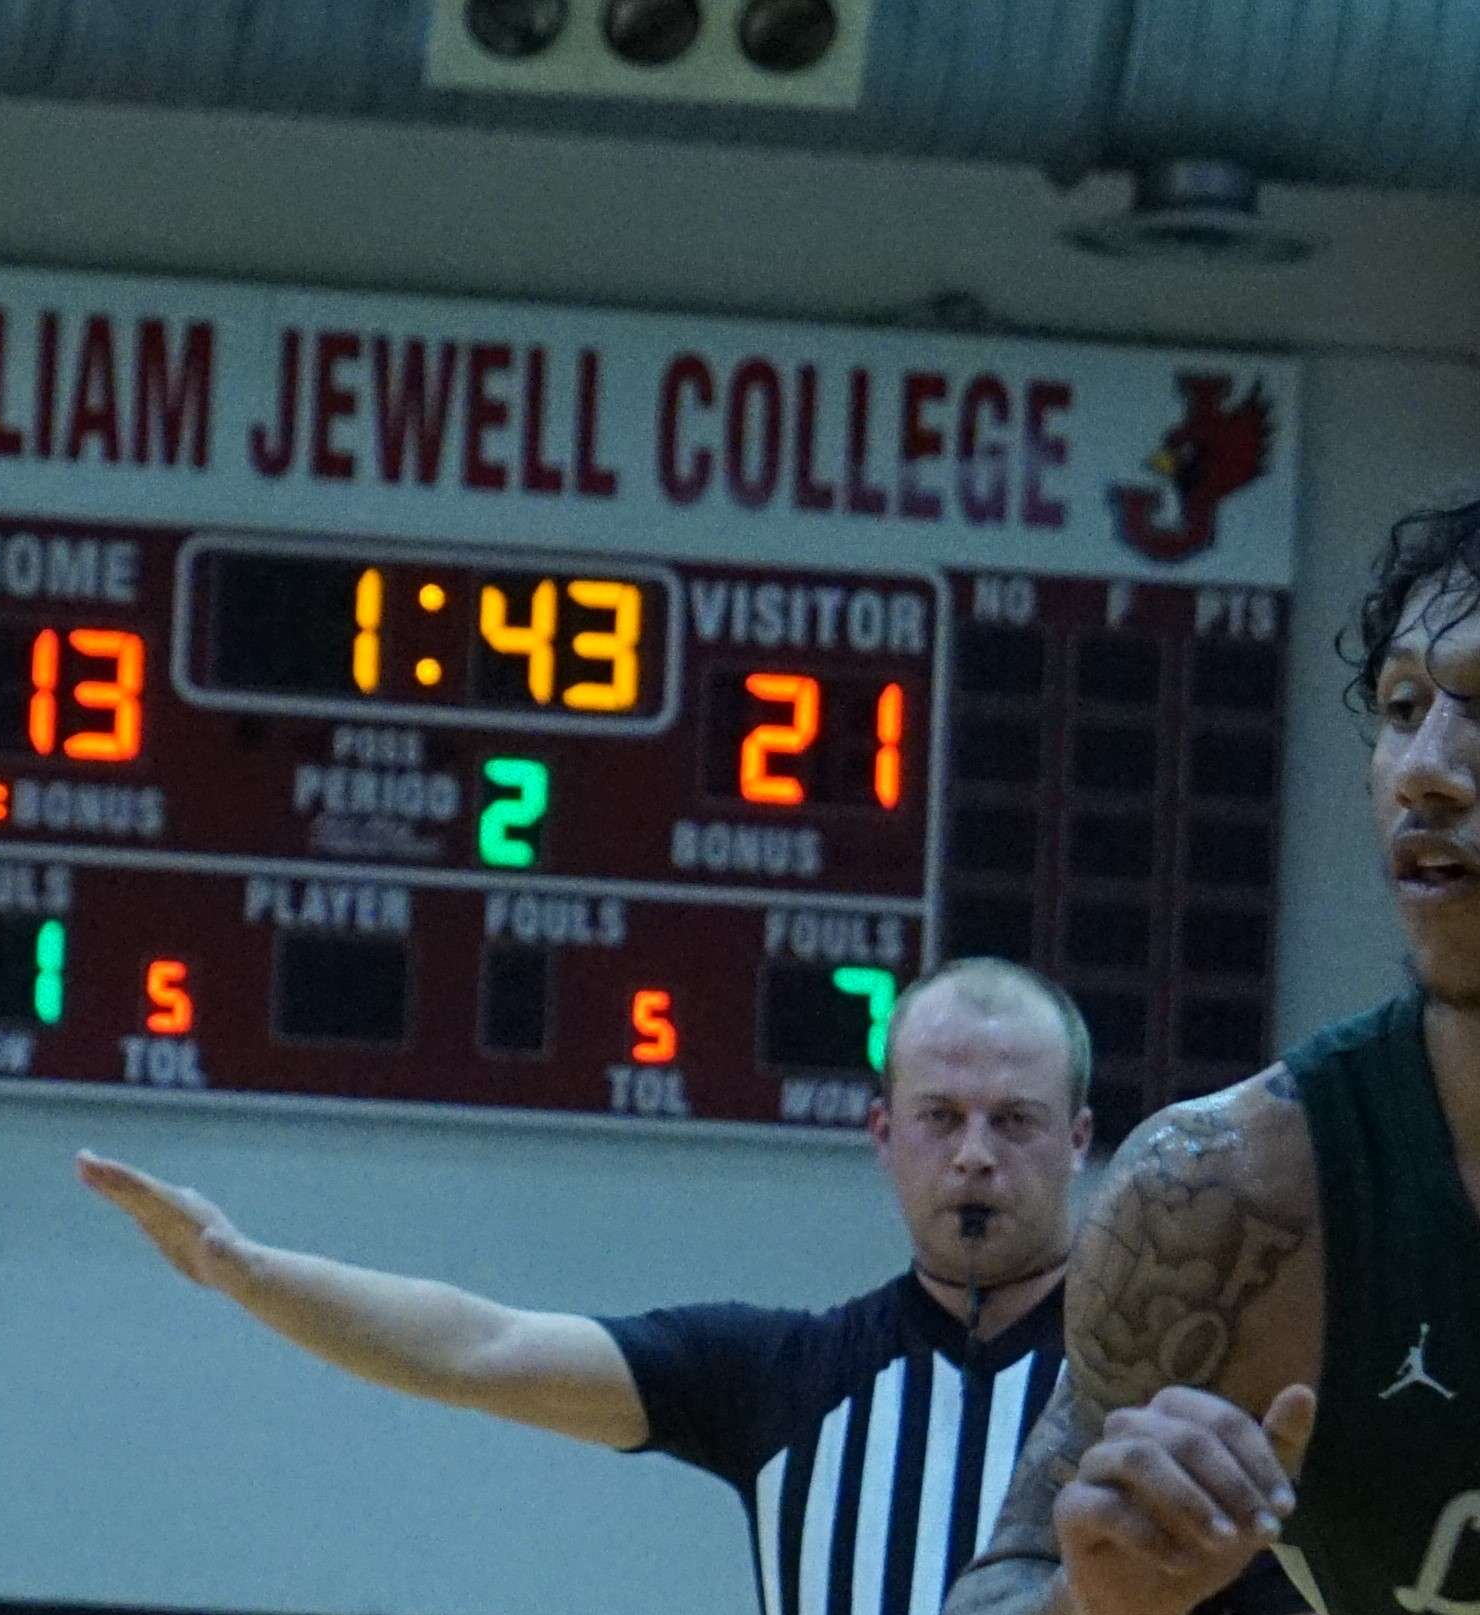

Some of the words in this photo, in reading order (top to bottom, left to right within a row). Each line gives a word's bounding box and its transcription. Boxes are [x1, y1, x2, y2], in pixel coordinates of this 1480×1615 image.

[248, 328, 618, 498] JEWELL
[656, 354, 1073, 530] COLLEGE
[352, 566, 641, 712] 1:43
[687, 580, 924, 652] VISITOR
[1194, 589, 1277, 641] PTS
[28, 627, 146, 763] 13
[739, 672, 904, 810] 21
[12, 777, 166, 837] BONUS
[293, 763, 462, 821] PERIOD
[478, 757, 550, 869] 2
[671, 819, 824, 878] BONUS
[244, 880, 410, 935] PLAYER
[484, 896, 628, 948] FOULS
[763, 910, 906, 960] FOULS
[33, 918, 67, 1026] 1
[145, 959, 195, 1036] 5
[631, 989, 679, 1065] 5
[831, 965, 897, 1075] 7
